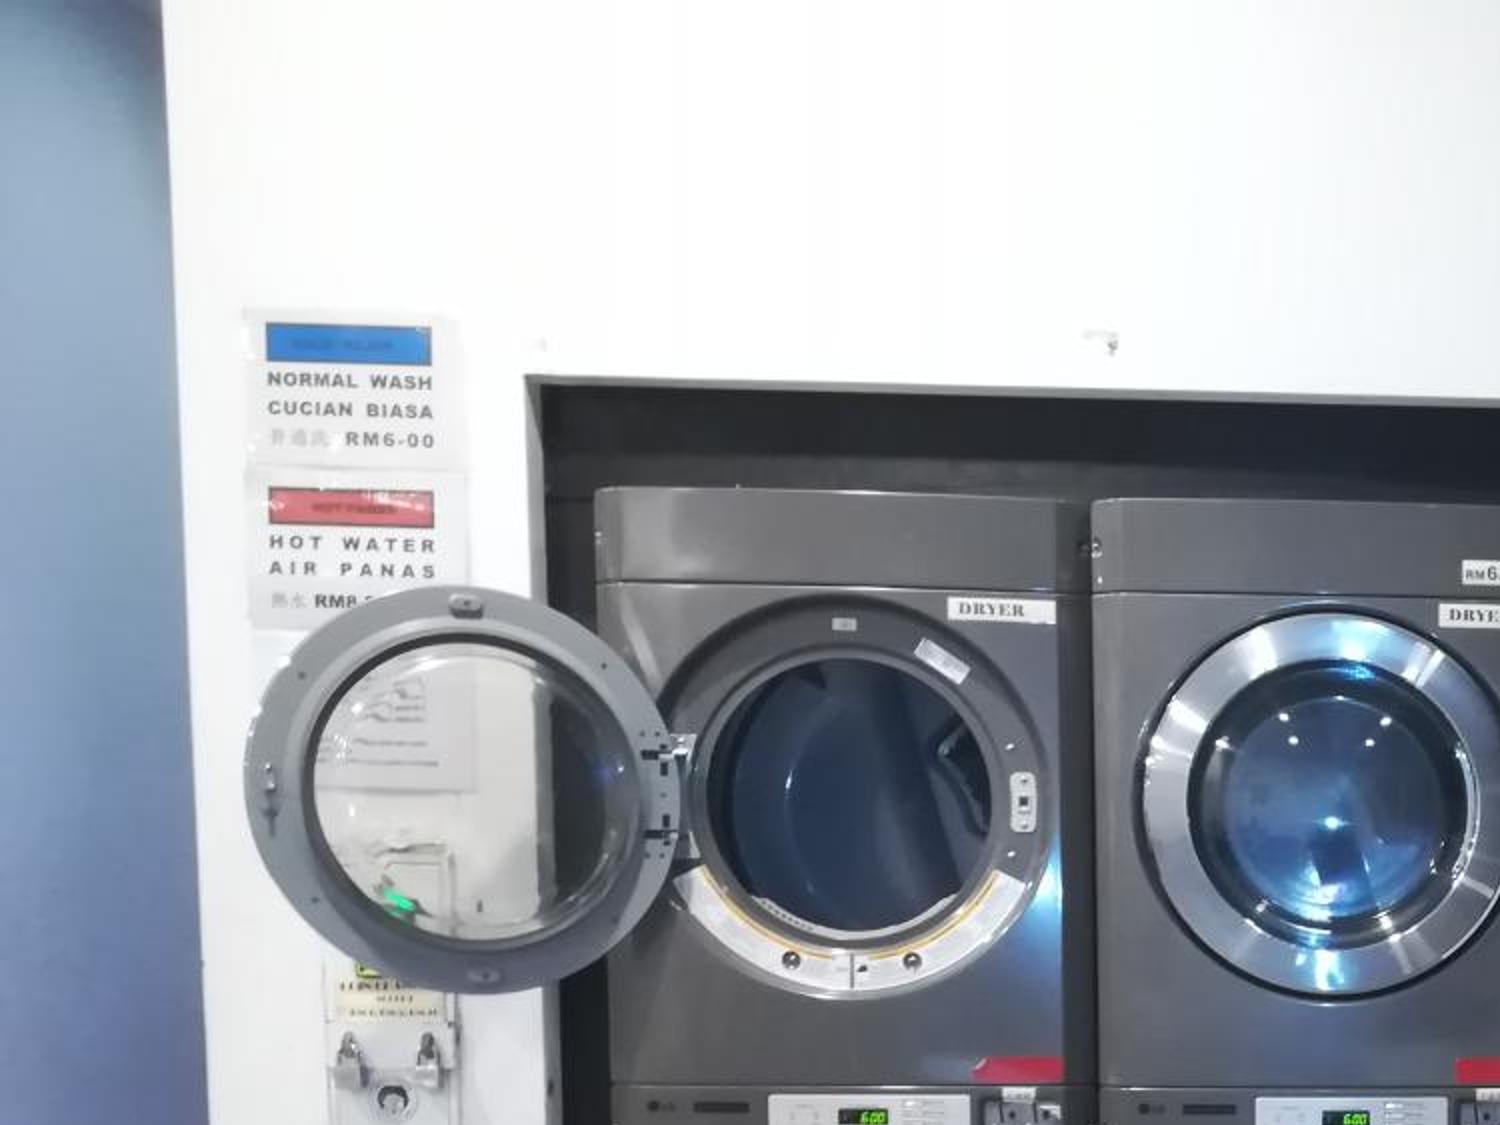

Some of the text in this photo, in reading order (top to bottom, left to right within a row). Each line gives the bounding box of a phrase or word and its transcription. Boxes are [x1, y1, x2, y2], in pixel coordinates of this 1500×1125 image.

[267, 371, 432, 391] NORMAL WASH
[267, 401, 433, 419] CUCIAN BIASA
[269, 536, 434, 553] HOT WATER
[269, 561, 434, 578] AIR PANAS
[958, 602, 1025, 618] DRYER
